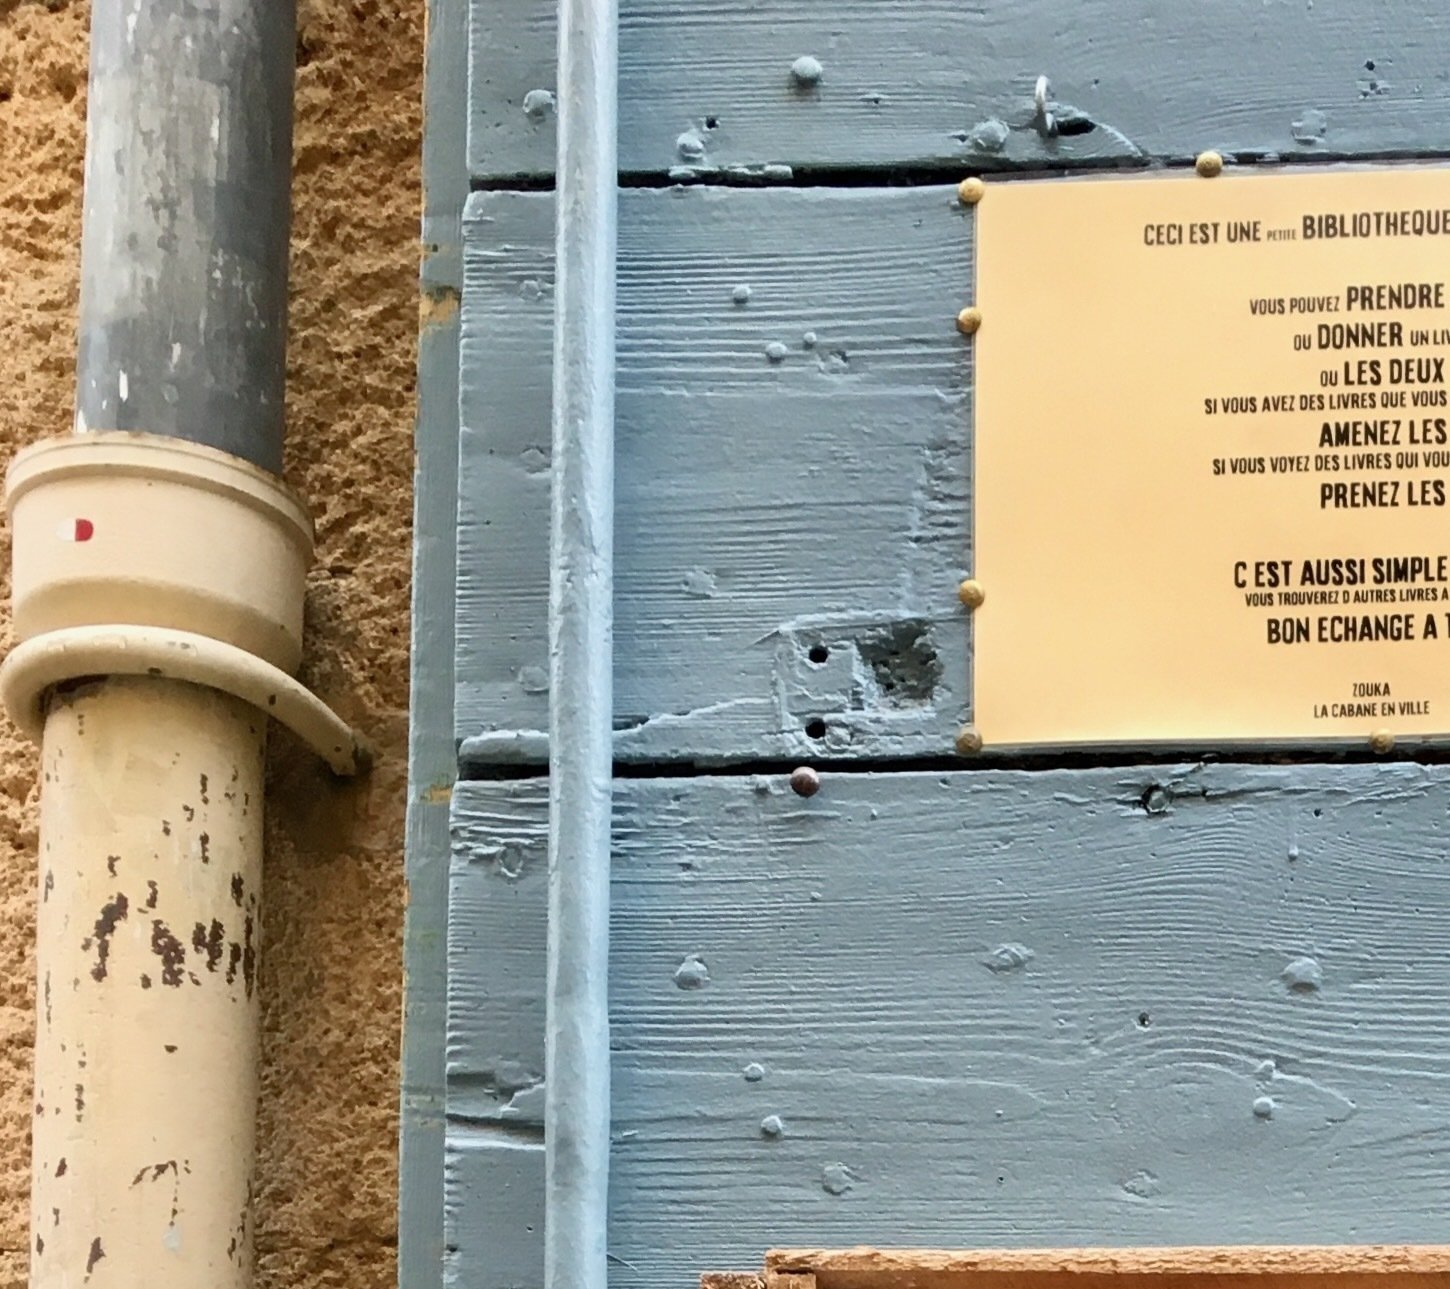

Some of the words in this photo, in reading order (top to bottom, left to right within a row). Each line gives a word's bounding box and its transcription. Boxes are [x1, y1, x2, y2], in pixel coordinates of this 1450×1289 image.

[1144, 223, 1183, 246] CECI
[1190, 222, 1219, 244] EST
[1227, 220, 1261, 243] UNE
[1267, 228, 1297, 241] PETITE
[1249, 298, 1285, 316] VOUS
[1290, 296, 1340, 314] POUVEZ
[1346, 283, 1445, 311] PRENDRE
[1294, 334, 1311, 351] OU
[1317, 322, 1403, 349] DONNER
[1411, 329, 1429, 346] UN
[1321, 370, 1338, 387] OU
[1344, 360, 1381, 385] LES
[1390, 358, 1445, 384] DEUX
[1205, 398, 1217, 414] SI
[1223, 397, 1256, 414] VOUS
[1262, 395, 1295, 412] AVEZ
[1300, 394, 1324, 411] DES
[1330, 392, 1376, 410] LIVRES
[1381, 391, 1405, 409] QUE
[1412, 390, 1447, 407] VOUS
[1319, 420, 1401, 447] AMENEZ
[1409, 418, 1447, 445] LES
[1213, 458, 1225, 475] SI
[1231, 457, 1265, 474] VOUS
[1270, 455, 1309, 473] VOYEZ
[1315, 454, 1339, 471] DES
[1344, 453, 1391, 471] LIVRES
[1397, 452, 1418, 469] QUI
[1320, 482, 1400, 509] PRENEZ
[1408, 479, 1445, 506] LES
[1255, 560, 1292, 588] EST
[1300, 558, 1365, 586] AUSSI
[1373, 555, 1447, 585] SIMPLE
[1245, 592, 1273, 606] VOUS
[1278, 590, 1338, 606] TROUVEREZ
[1354, 589, 1396, 604] AUTRES
[1400, 587, 1438, 602] LIVRES
[1442, 587, 1449, 601] A
[1267, 617, 1310, 644] BON
[1318, 613, 1414, 643] ECHANGE
[1423, 613, 1437, 640] A
[1353, 682, 1390, 697] ZOUKA
[1314, 704, 1328, 718] LA
[1332, 702, 1377, 718] CABANE
[1382, 702, 1395, 717] EN
[1398, 700, 1429, 715] VILLE
